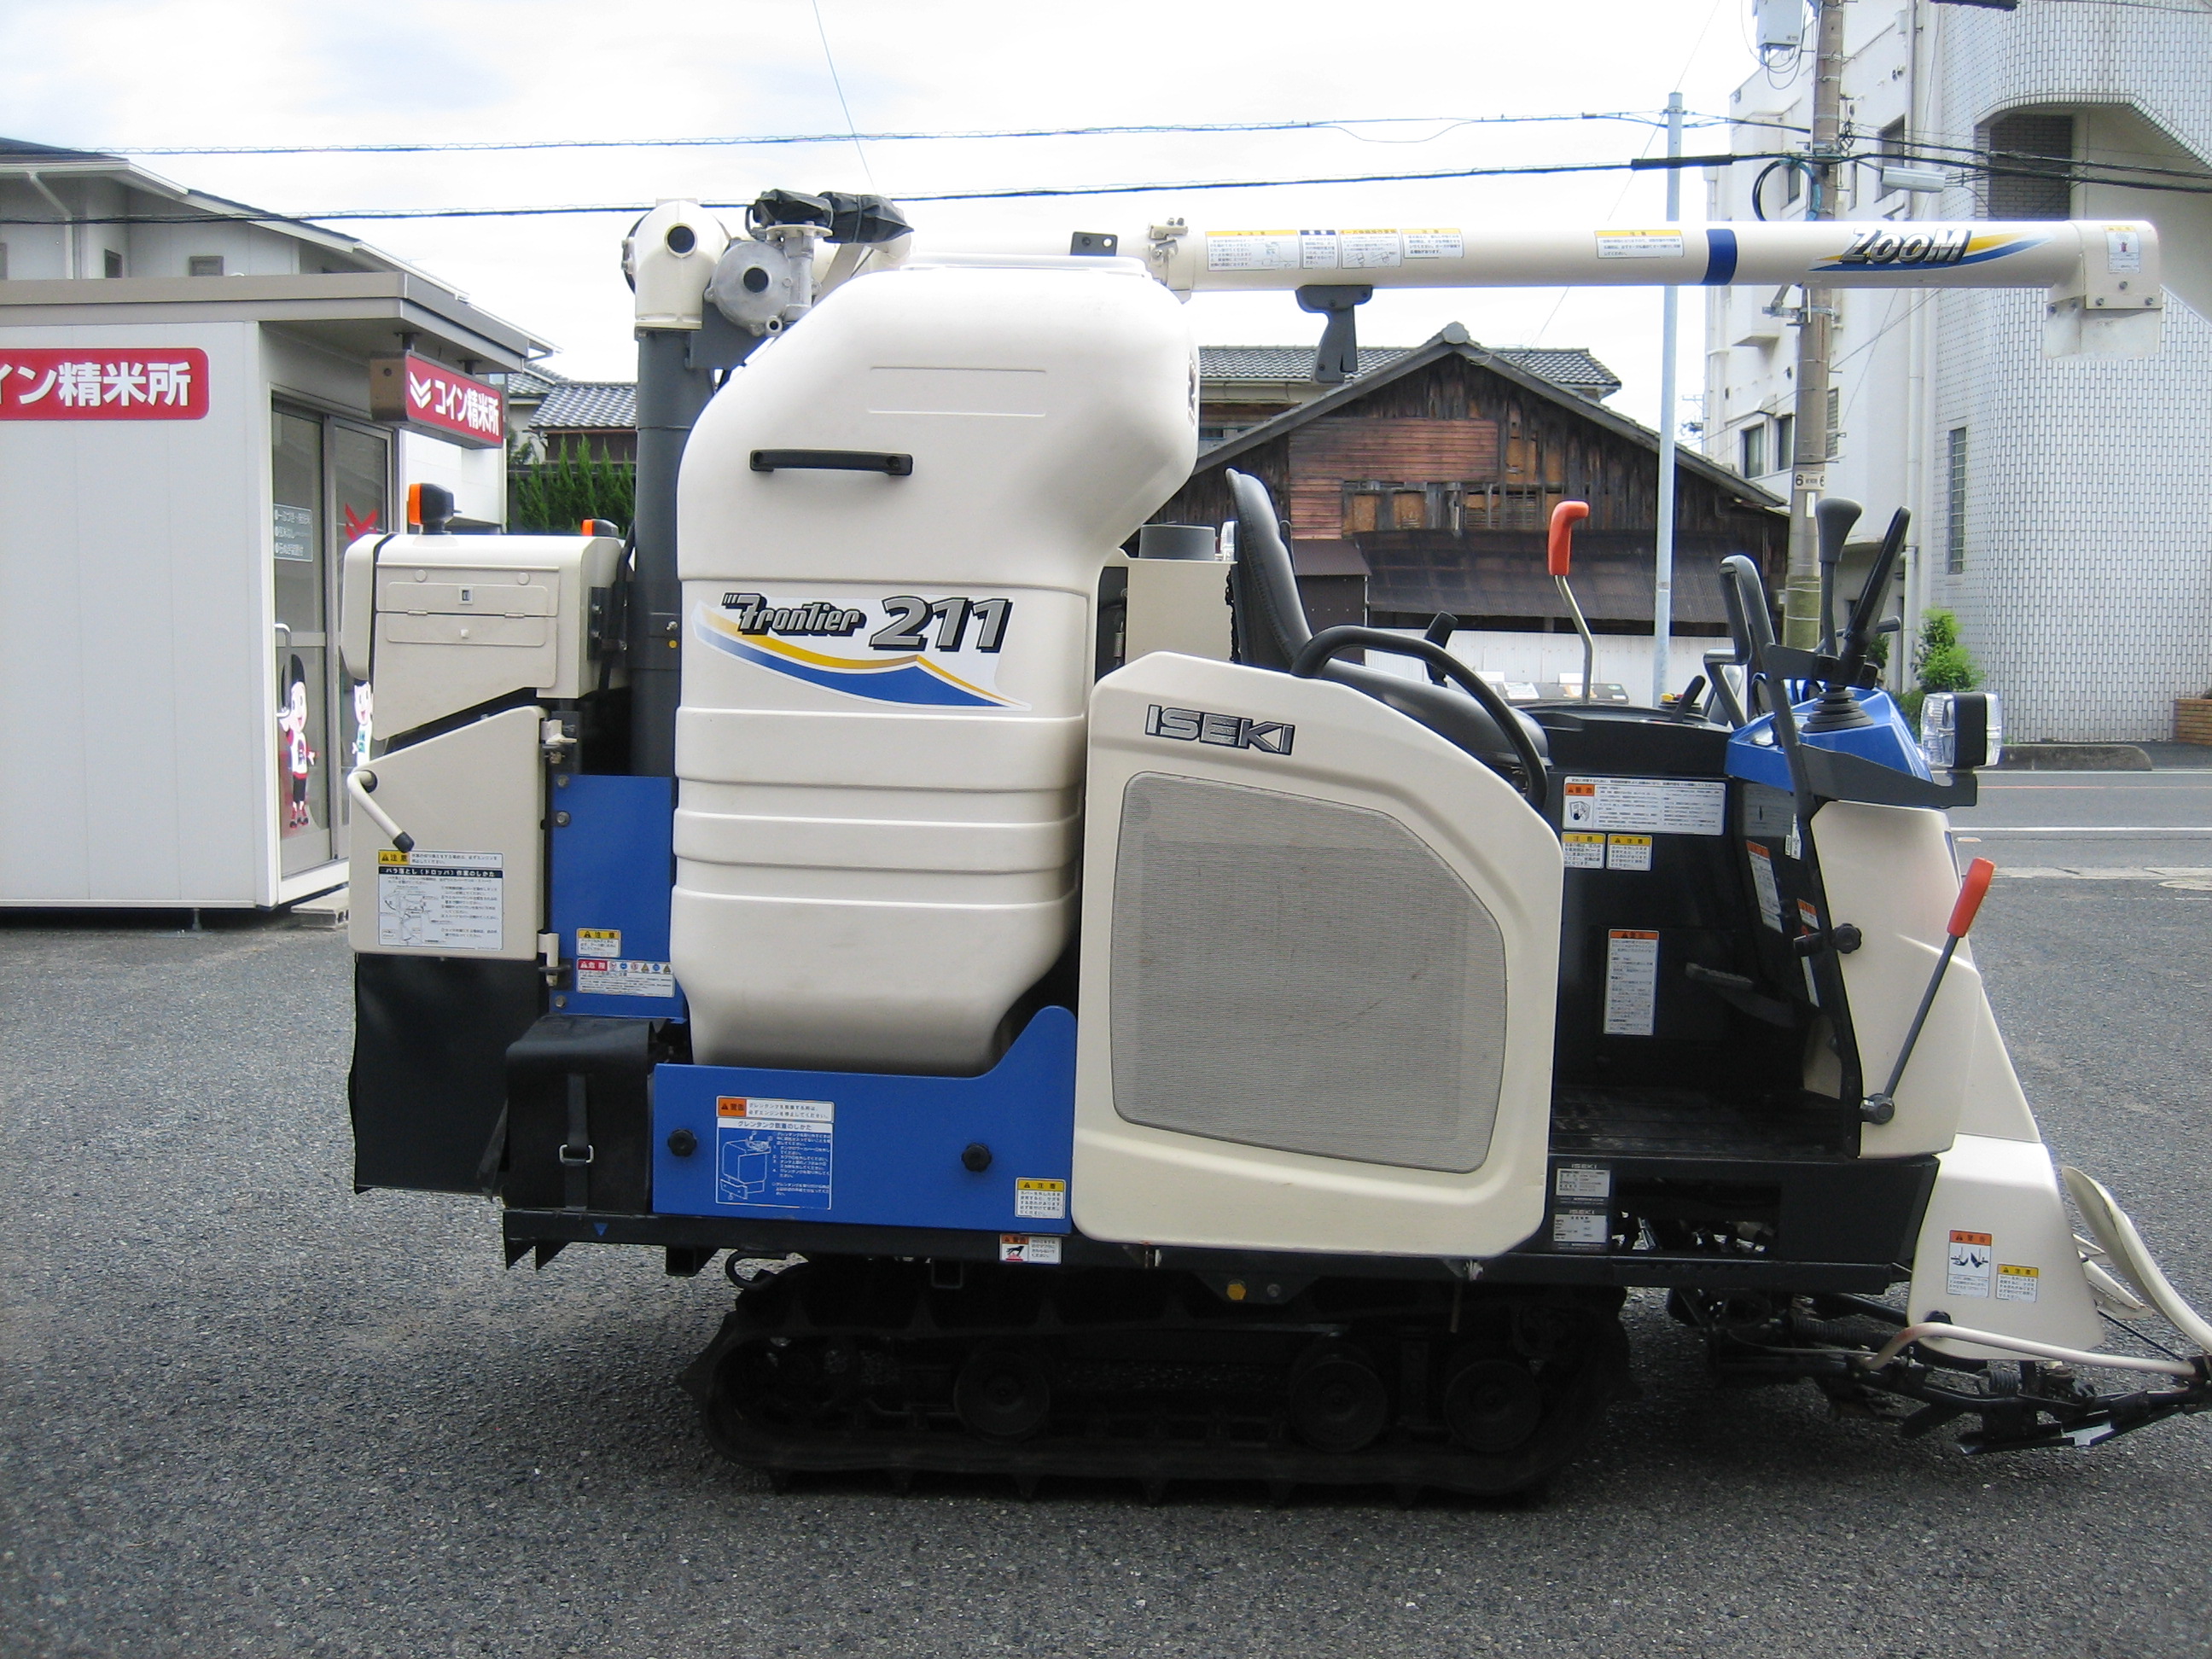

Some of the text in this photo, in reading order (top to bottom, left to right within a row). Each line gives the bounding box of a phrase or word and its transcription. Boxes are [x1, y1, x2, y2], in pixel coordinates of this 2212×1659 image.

[1840, 228, 1972, 265] ZOOM
[434, 379, 499, 436] コイン精米所
[721, 592, 1013, 653] Frontier 211
[1145, 704, 1295, 756] ISEKI
